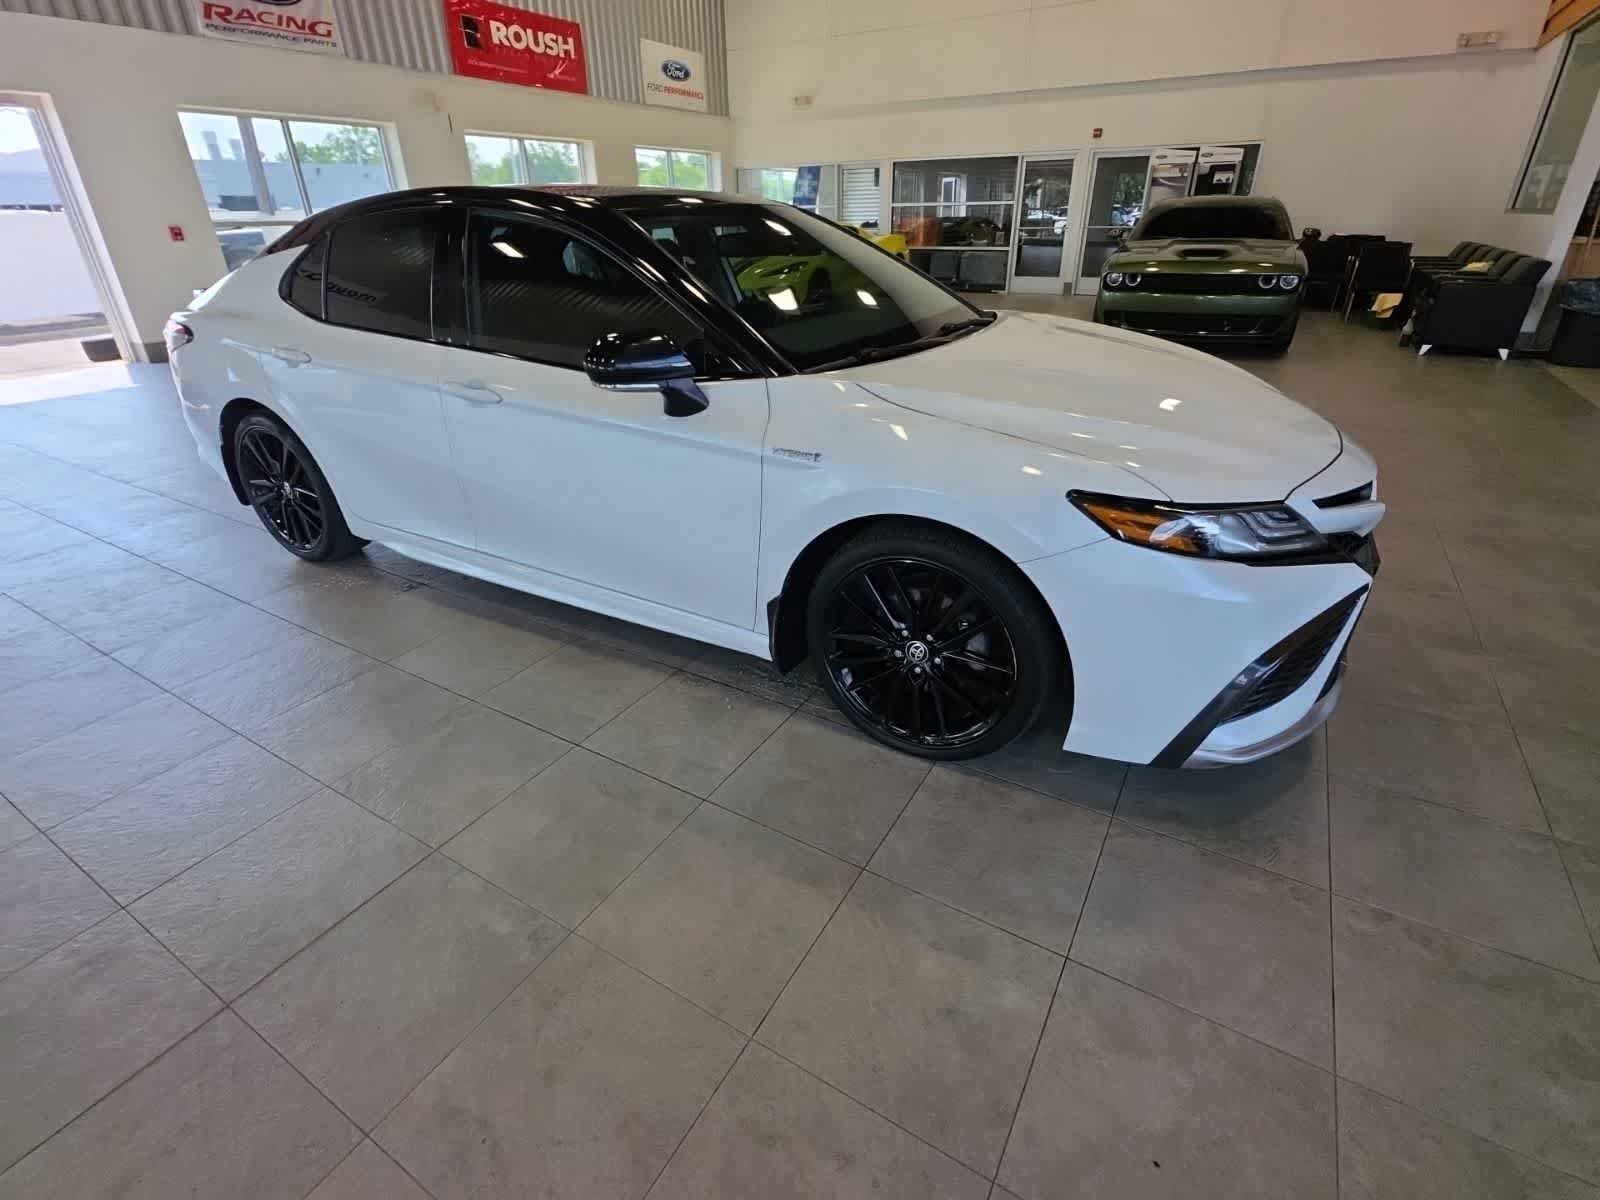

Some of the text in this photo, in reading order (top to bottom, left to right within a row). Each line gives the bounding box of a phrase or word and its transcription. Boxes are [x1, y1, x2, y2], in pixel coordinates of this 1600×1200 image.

[203, 3, 332, 37] RACING
[206, 23, 336, 48] PERFORMANCE PARTS
[489, 20, 575, 59] ROUSH
